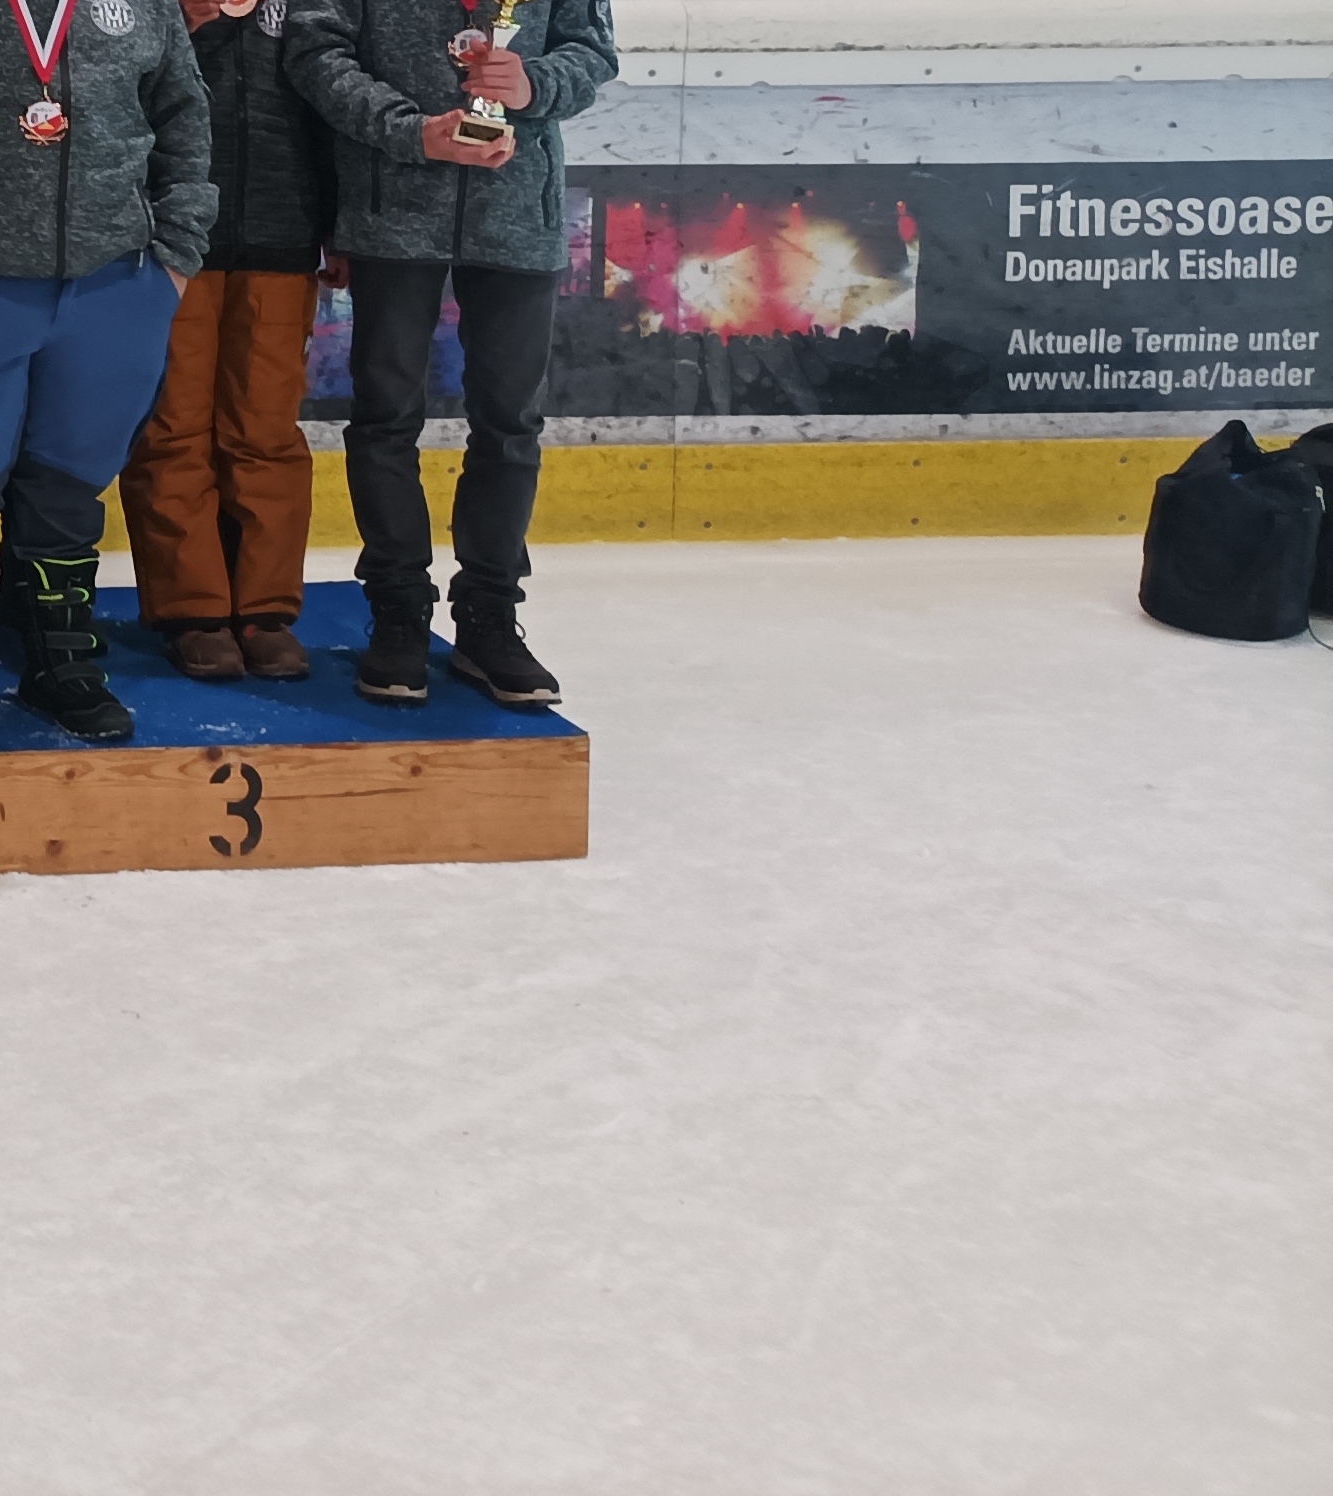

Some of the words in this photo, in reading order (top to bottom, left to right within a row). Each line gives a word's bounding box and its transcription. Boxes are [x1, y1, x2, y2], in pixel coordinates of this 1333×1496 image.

[1009, 184, 1333, 237] Fitnessoase
[1005, 250, 1170, 289] Donaupark
[1179, 248, 1298, 280] Eishalle
[1007, 328, 1123, 355] Aktuelle
[1132, 326, 1239, 354] Termine
[1248, 330, 1319, 351] unter
[1007, 361, 1316, 395] www.linzag.at/baeder
[209, 763, 262, 856] 3
